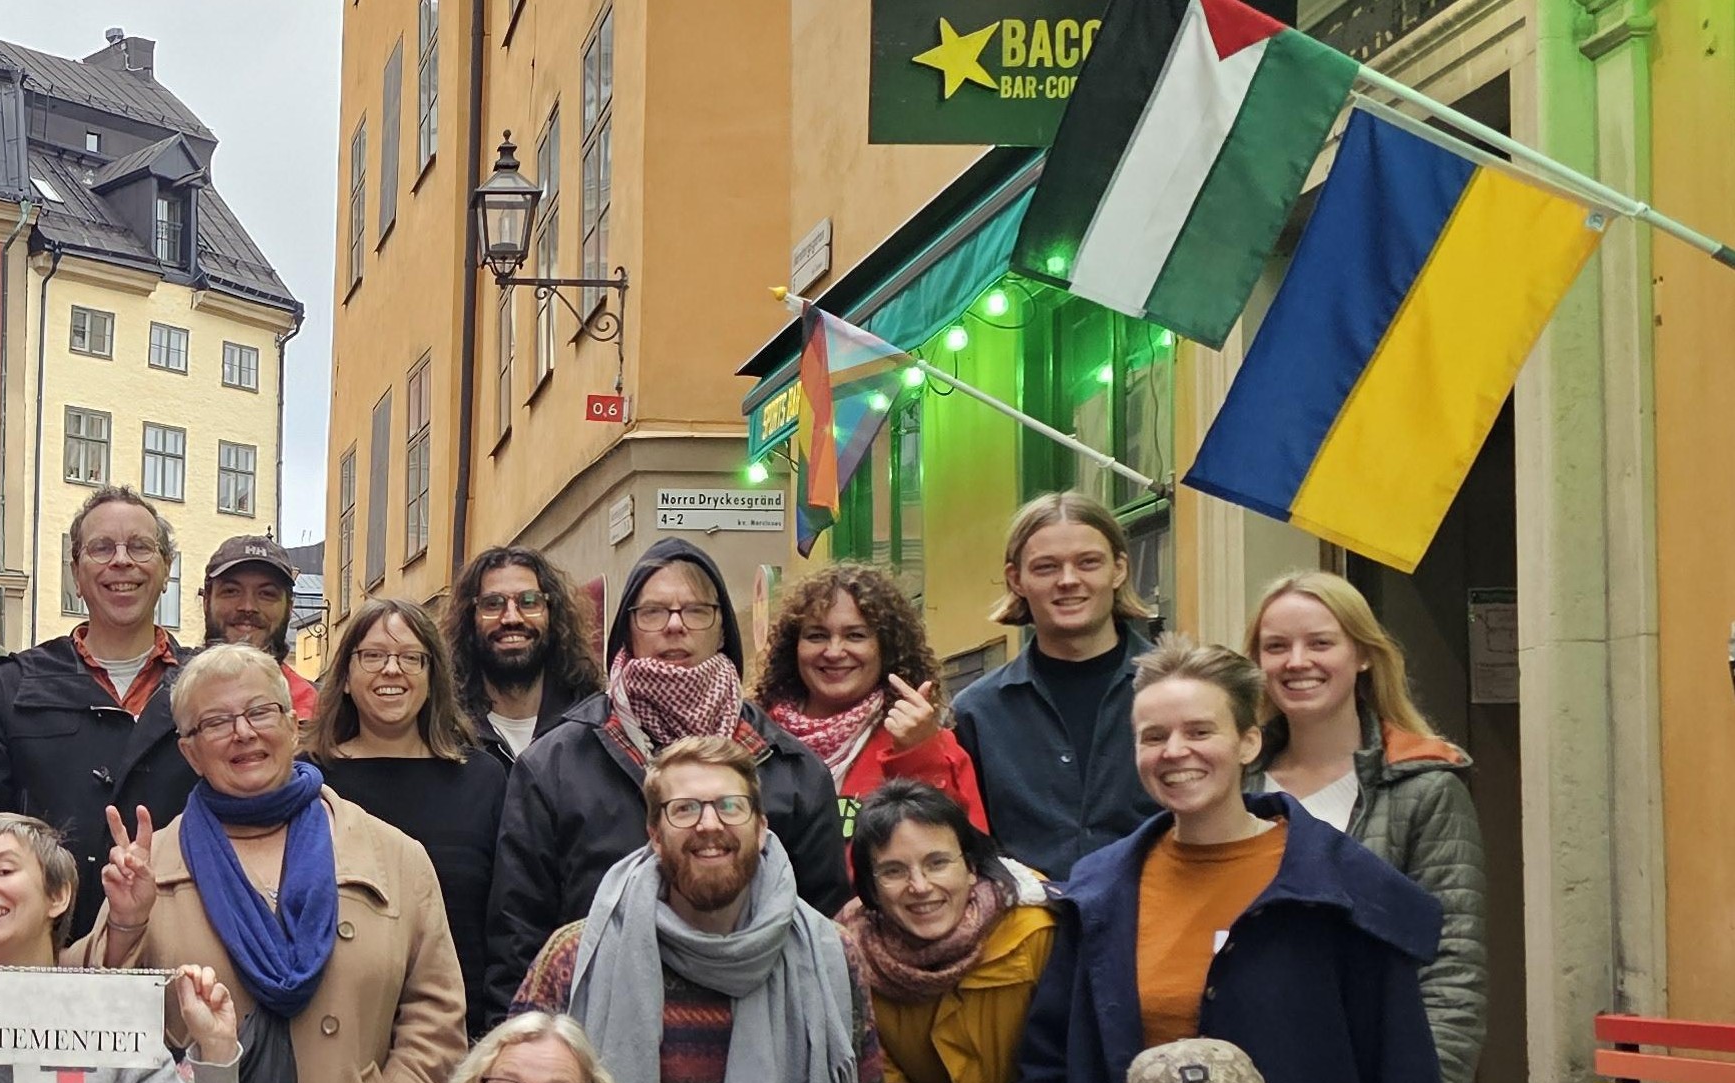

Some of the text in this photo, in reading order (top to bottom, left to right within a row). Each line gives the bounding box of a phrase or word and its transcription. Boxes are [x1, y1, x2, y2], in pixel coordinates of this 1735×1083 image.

[661, 493, 782, 509] Norra Dryckesgränd
[661, 513, 684, 525] 4-2
[245, 545, 268, 557] HH
